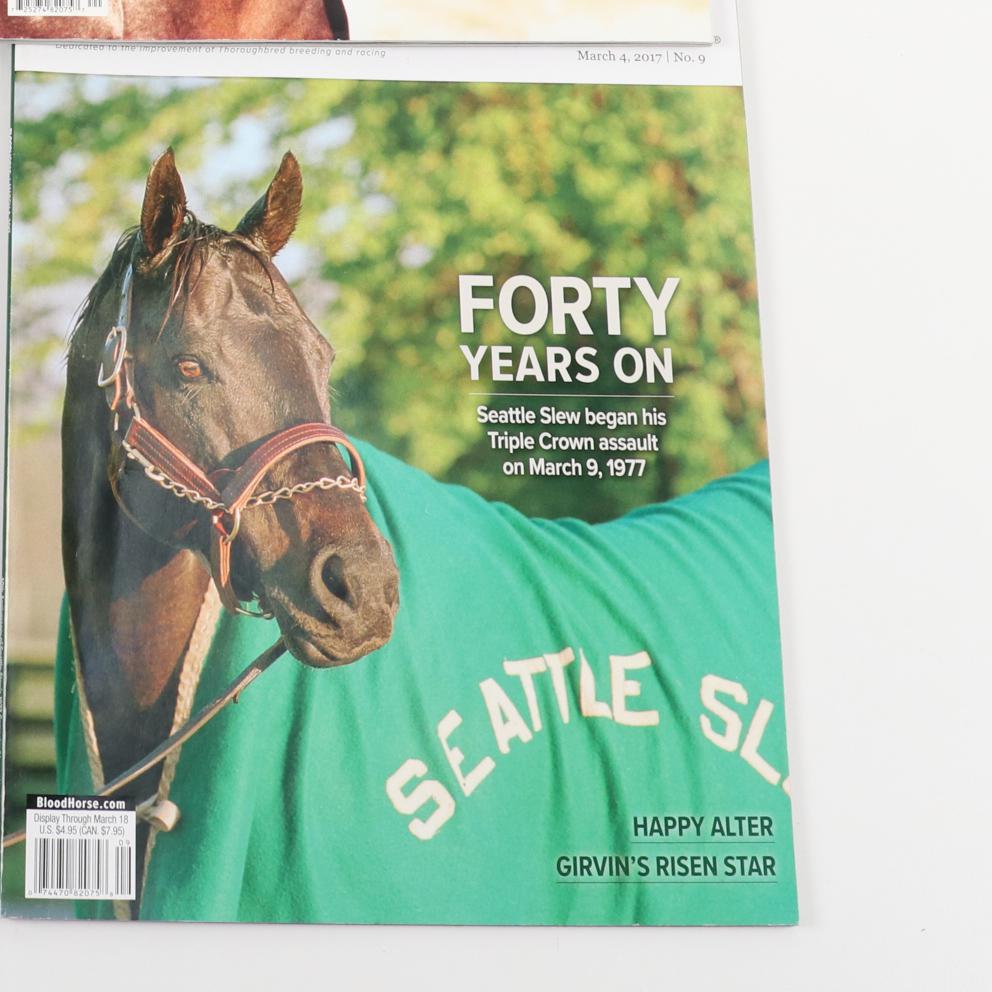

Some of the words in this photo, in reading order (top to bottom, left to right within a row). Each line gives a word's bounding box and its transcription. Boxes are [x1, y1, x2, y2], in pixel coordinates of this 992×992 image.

[139, 45, 202, 54] improvement
[205, 45, 215, 53] of
[219, 46, 285, 55] Thoroughbred
[289, 46, 331, 56] breeding
[335, 48, 352, 56] and
[356, 49, 386, 57] racing
[578, 50, 615, 61] March
[619, 53, 631, 63] 4,
[634, 53, 662, 63] 2017
[673, 51, 695, 63] No.
[698, 55, 706, 64] 9
[458, 274, 680, 336] FORTY
[459, 344, 600, 383] YEARS
[613, 346, 674, 384] ON
[476, 405, 536, 424] Seattle
[539, 406, 580, 425] Slew
[584, 407, 638, 430] began
[642, 408, 667, 426] his
[487, 431, 535, 453] Triple
[538, 432, 595, 451] Crown
[598, 433, 659, 452] assault
[502, 460, 524, 476] on
[529, 457, 582, 476] March
[586, 458, 603, 480] 9,
[607, 459, 647, 477] 1977
[385, 646, 660, 842] SEATTLE
[36, 796, 126, 810] BloodHorse.com
[33, 813, 60, 824] Display
[62, 813, 92, 825] Through
[93, 814, 117, 824] March
[119, 815, 129, 824] 18
[633, 816, 705, 837] HAPPY
[710, 816, 774, 837] ALTER
[39, 826, 53, 835] U.S.
[56, 826, 78, 835] $4.95
[100, 826, 125, 836] $7.95)
[556, 855, 650, 877] GIRVIN'S
[656, 855, 718, 877] RISEN
[723, 855, 776, 877] STAR
